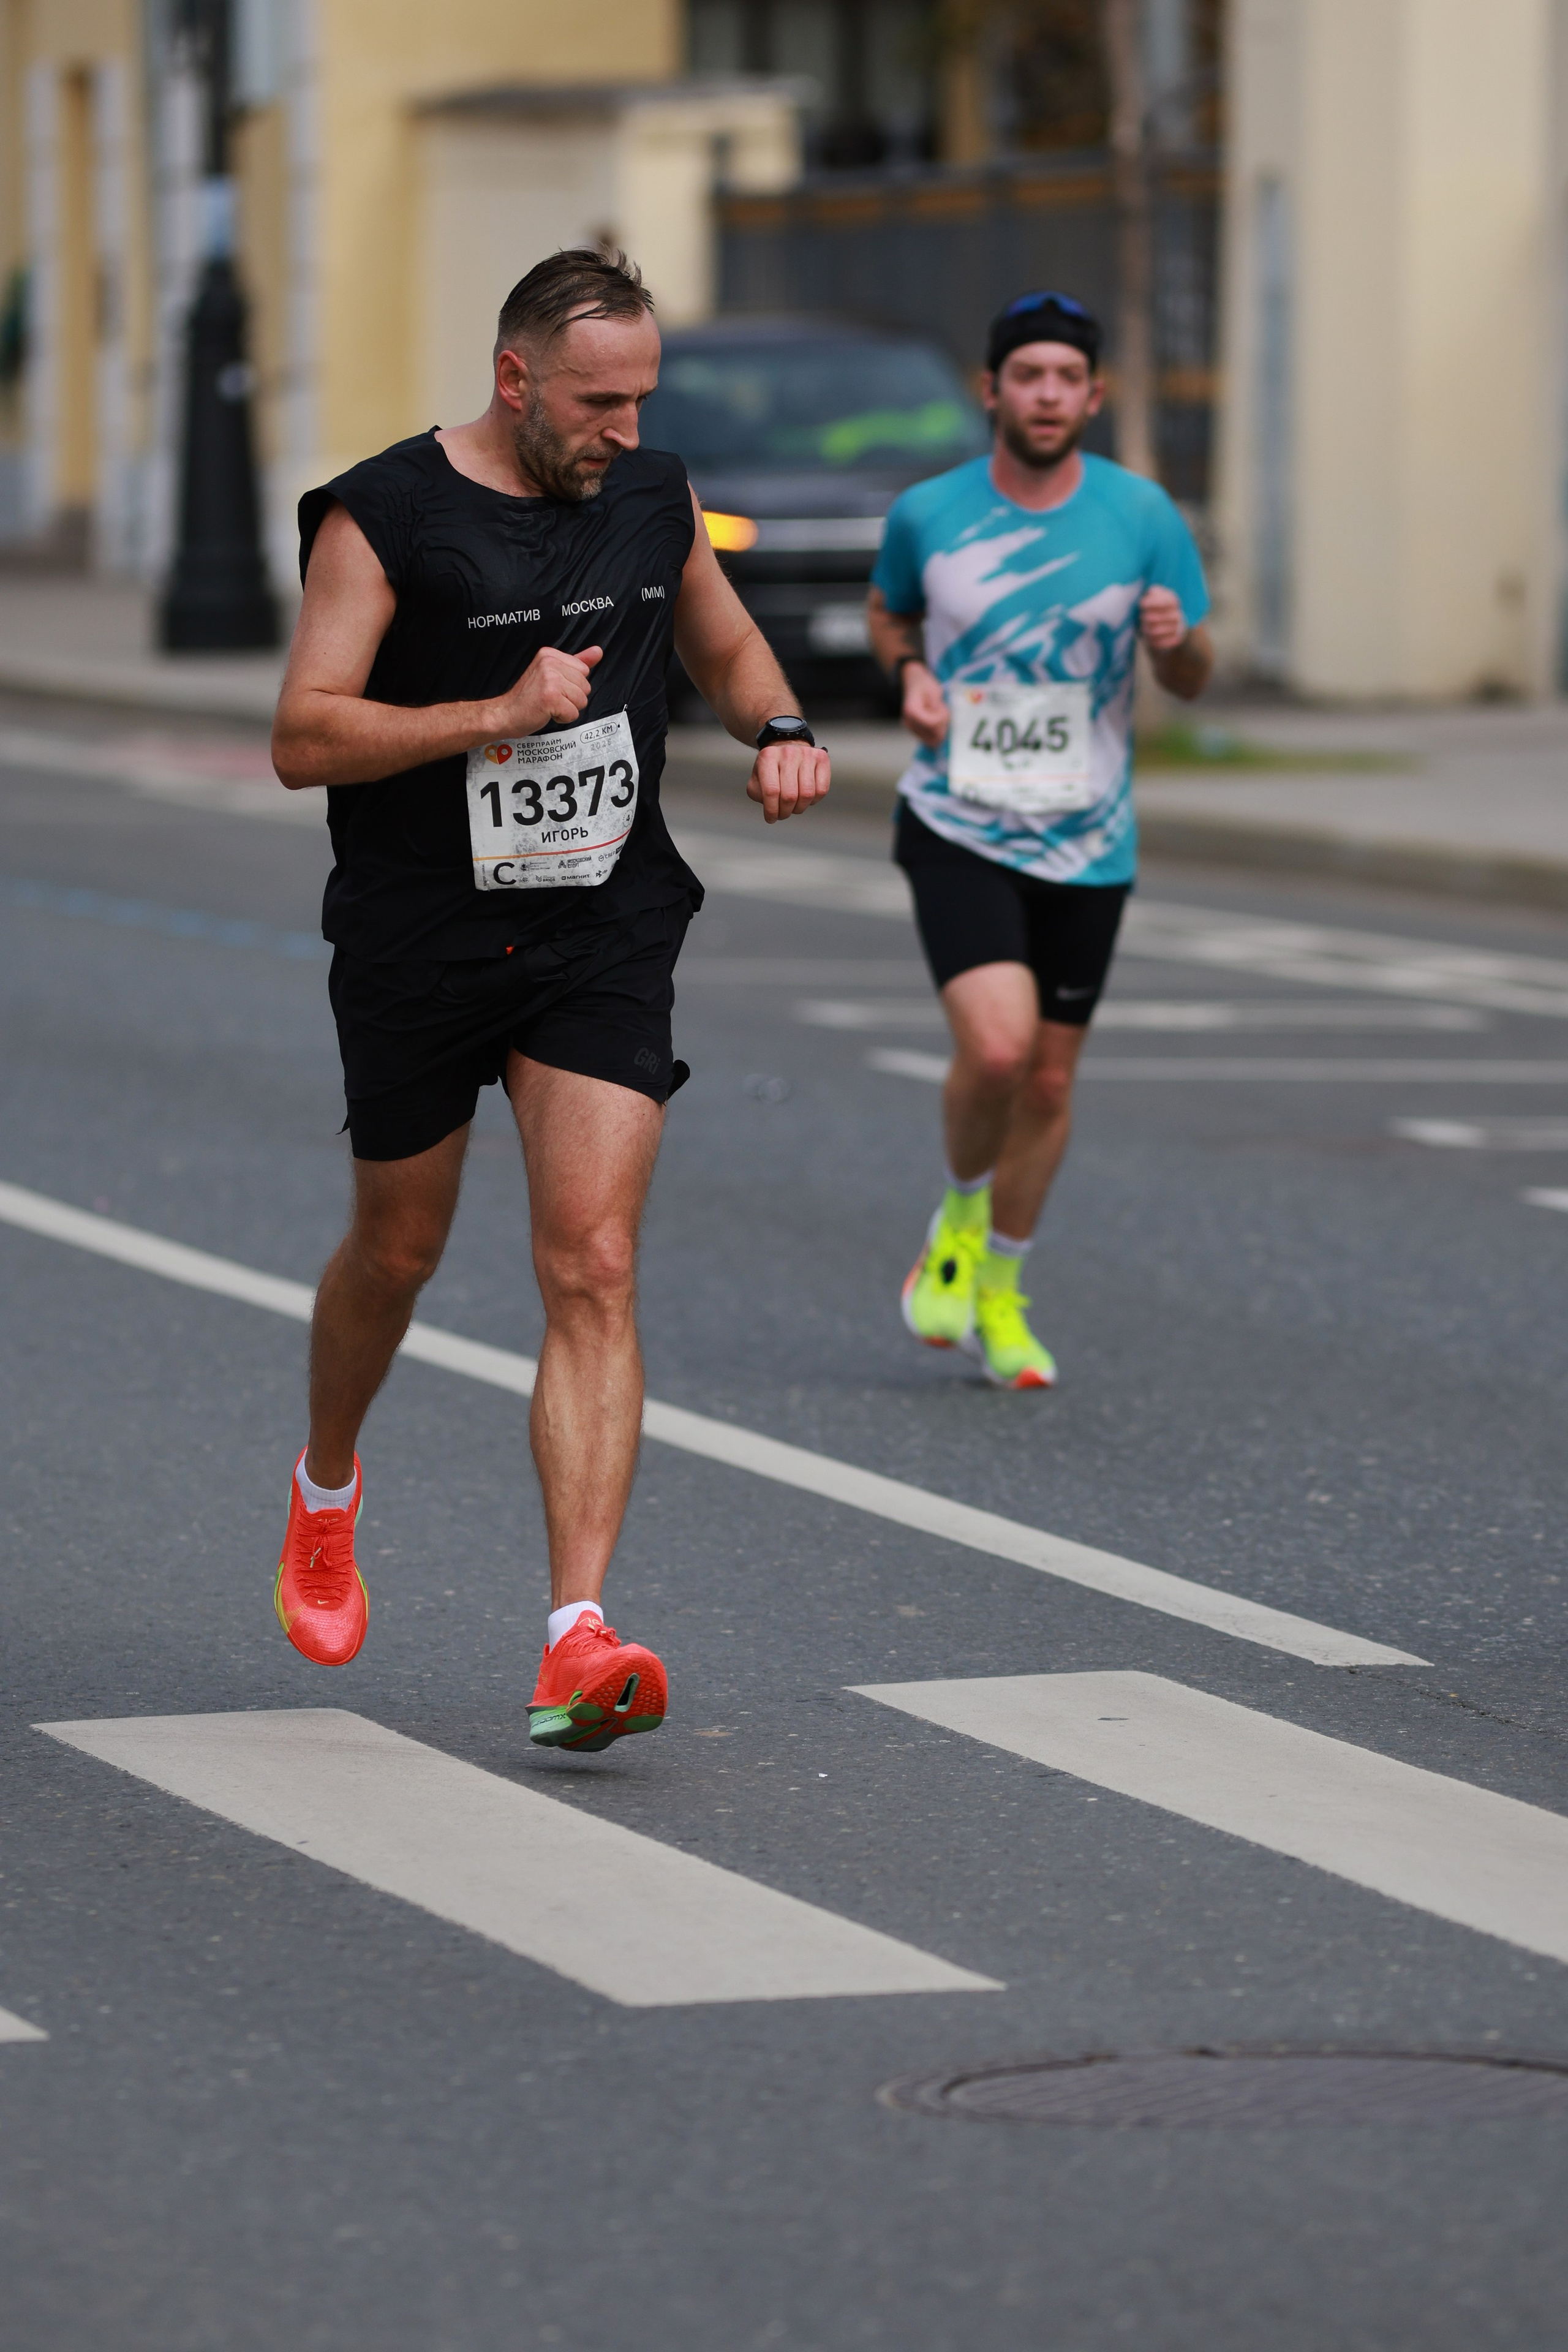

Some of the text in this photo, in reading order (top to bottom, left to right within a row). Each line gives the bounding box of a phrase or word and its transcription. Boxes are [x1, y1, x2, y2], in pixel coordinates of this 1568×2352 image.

[467, 585, 665, 629] НОРМАТИВ МОСКВА (ММ)
[584, 725, 613, 740] 42,2 КМ
[970, 715, 1070, 756] 4045
[516, 738, 562, 748] СБЕРПРАЙМ
[517, 740, 576, 756] МОСКОВСКИЙ
[518, 753, 563, 764] МАРАФОН
[480, 759, 635, 827] 13373
[541, 827, 589, 843] ИГОРЬ
[493, 862, 516, 885] C
